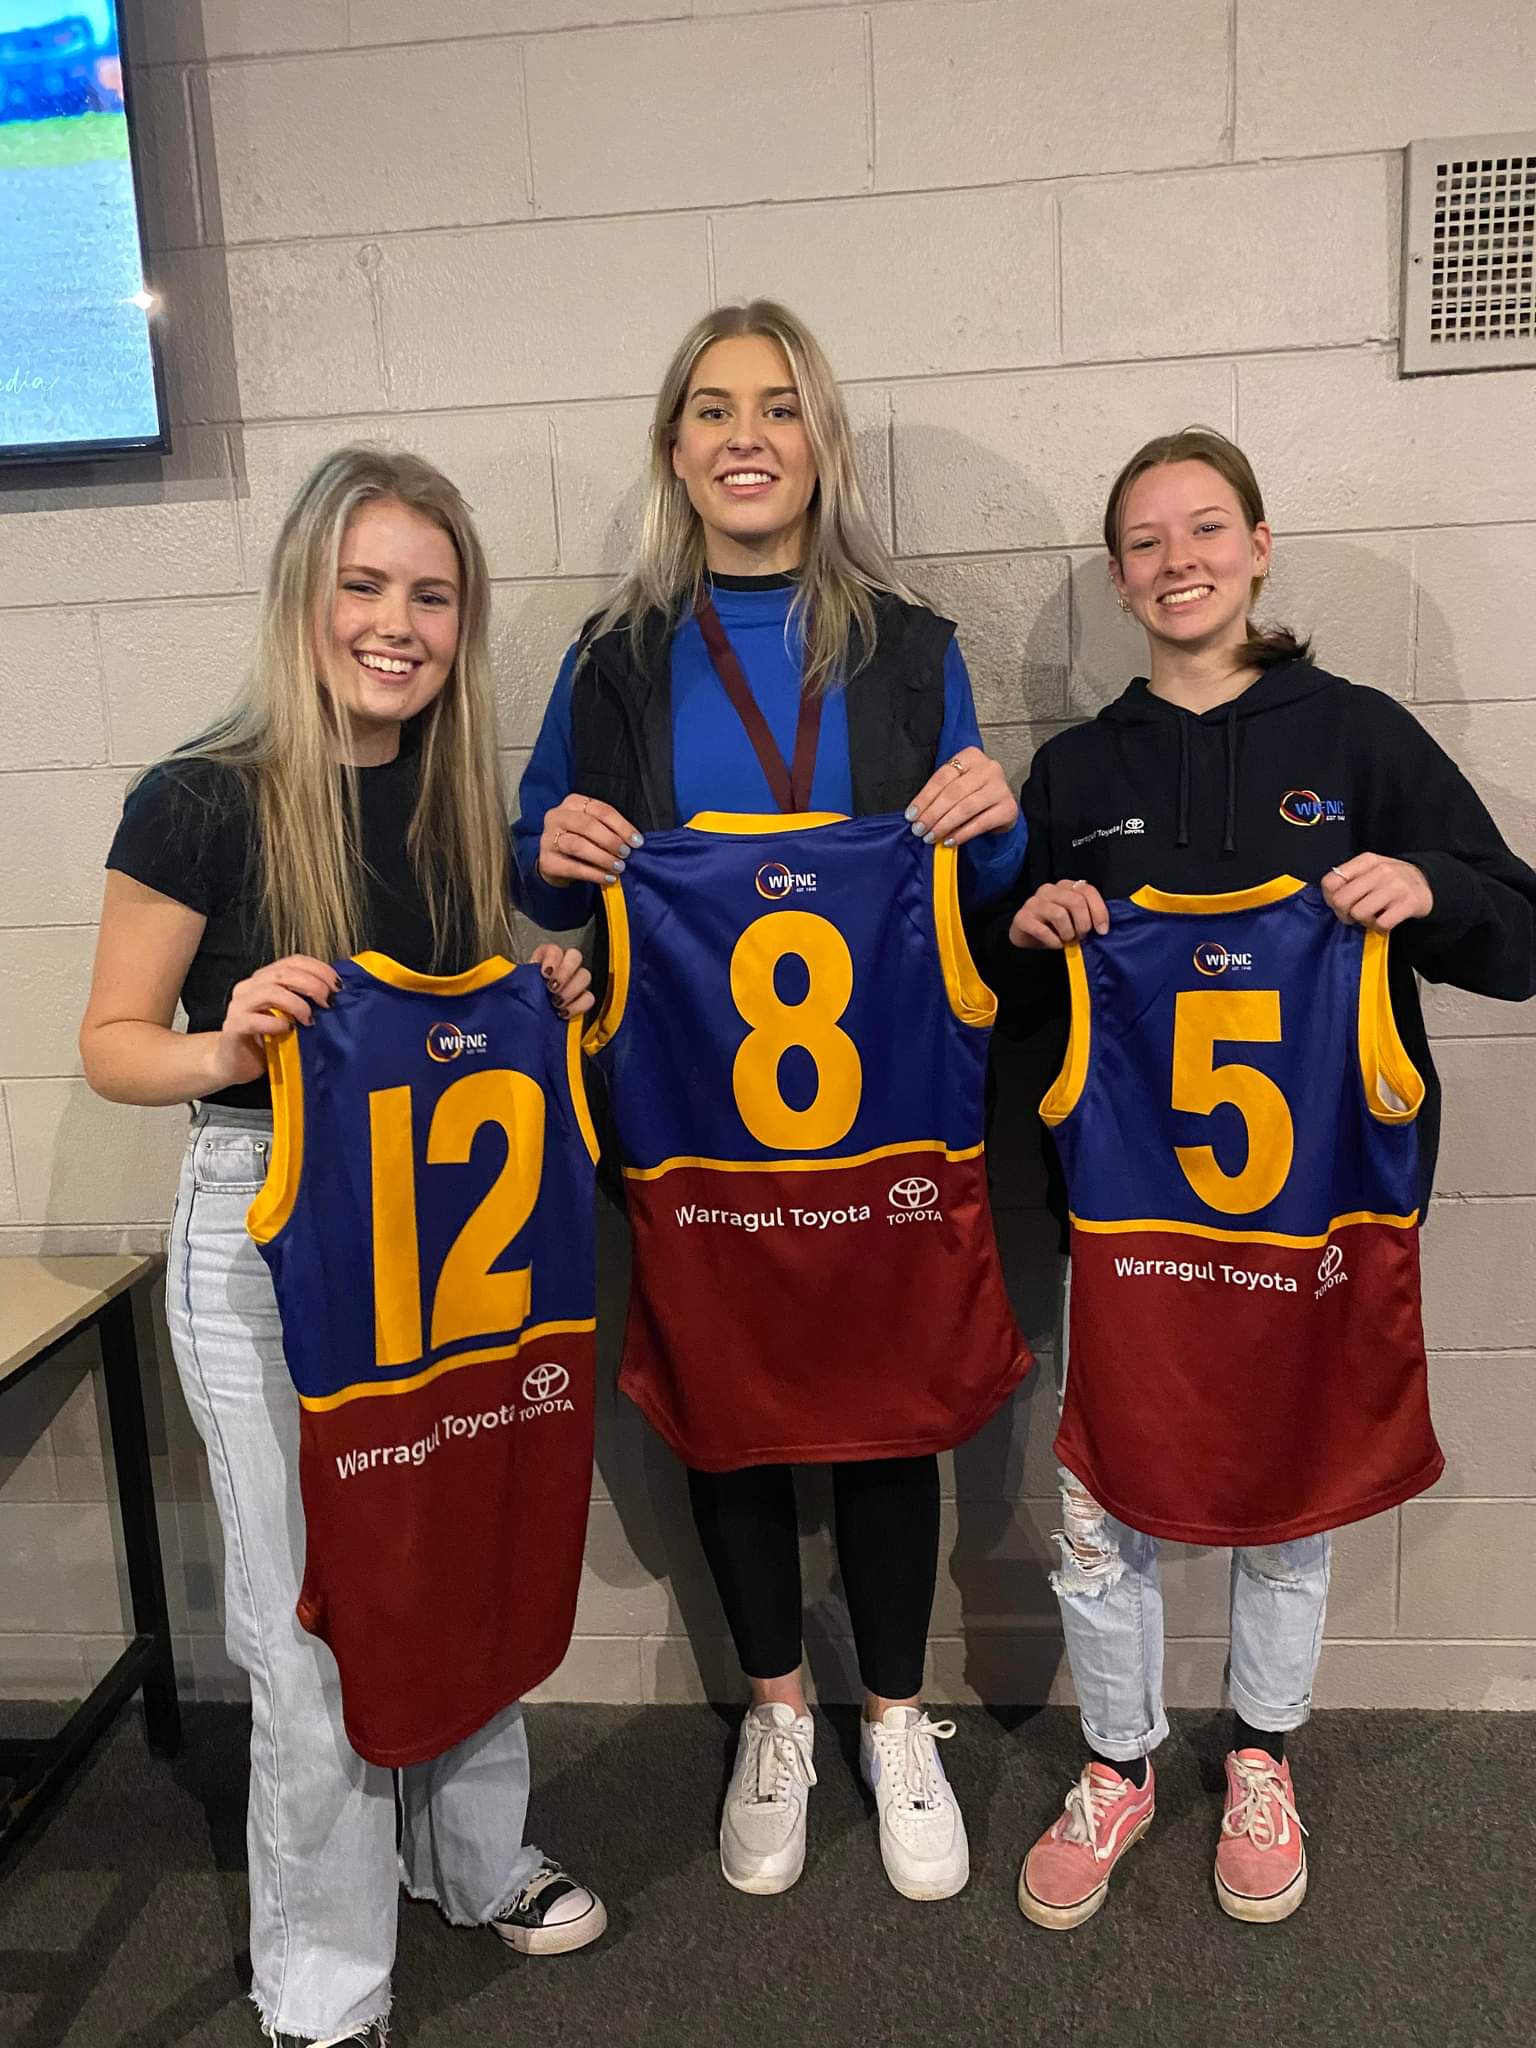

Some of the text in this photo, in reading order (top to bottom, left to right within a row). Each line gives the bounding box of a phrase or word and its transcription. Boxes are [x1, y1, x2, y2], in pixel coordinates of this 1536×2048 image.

[768, 873, 817, 889] WIFNC
[1205, 953, 1252, 966] WIFNC
[439, 1033, 487, 1050] WIFNC
[730, 910, 862, 1151] 8
[1171, 990, 1294, 1215] 5
[368, 1069, 546, 1367] 12
[675, 1204, 871, 1232] Warragul Toyota
[887, 1210, 943, 1226] TOYOTA
[1114, 1257, 1298, 1293] Warragul Toyota
[1313, 1271, 1349, 1300] TOYOTA
[520, 1399, 575, 1422] TOYOTA
[336, 1422, 441, 1480] Warragul
